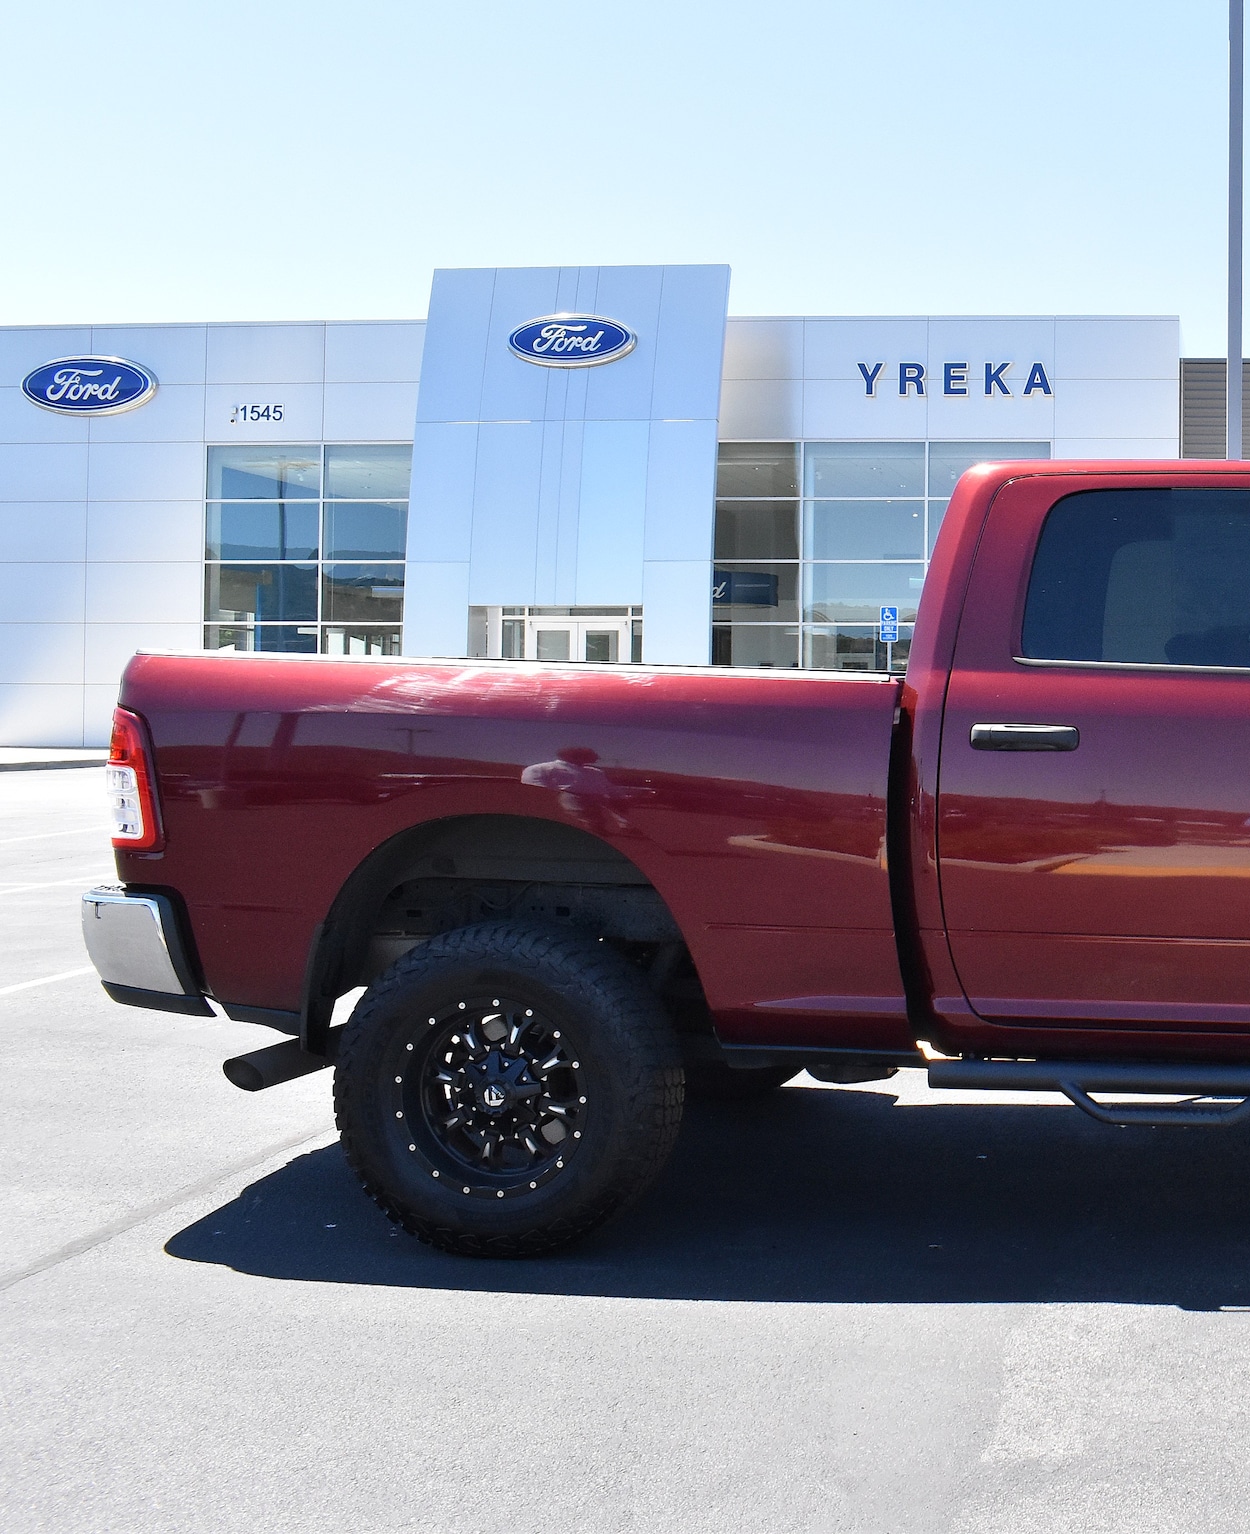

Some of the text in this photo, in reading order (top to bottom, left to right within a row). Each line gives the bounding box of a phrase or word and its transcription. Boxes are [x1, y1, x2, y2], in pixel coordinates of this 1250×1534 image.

[532, 324, 605, 352] Ford
[46, 368, 121, 400] Ford
[857, 362, 1054, 397] YREKA
[240, 405, 283, 421] 1545
